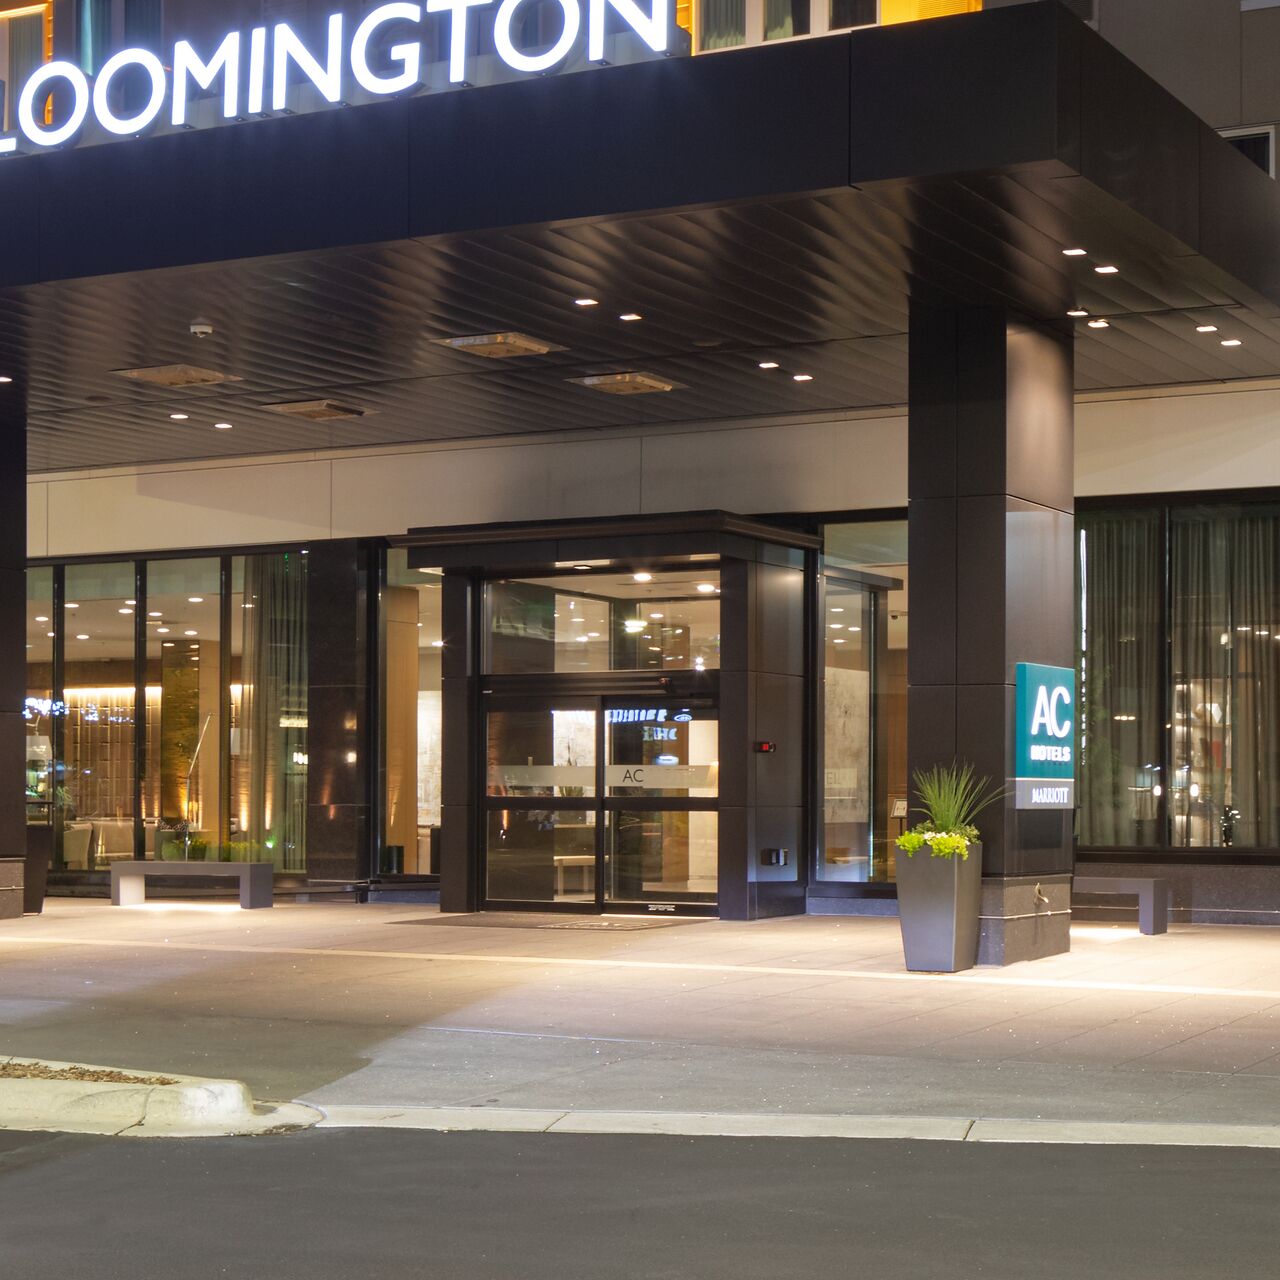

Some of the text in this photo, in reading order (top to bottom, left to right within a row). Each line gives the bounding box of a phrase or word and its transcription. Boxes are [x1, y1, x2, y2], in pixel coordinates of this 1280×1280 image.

[1031, 685, 1071, 738] AC
[1030, 744, 1071, 762] HOTELS
[622, 769, 644, 783] AC
[1031, 787, 1069, 804] MARRIOTT
